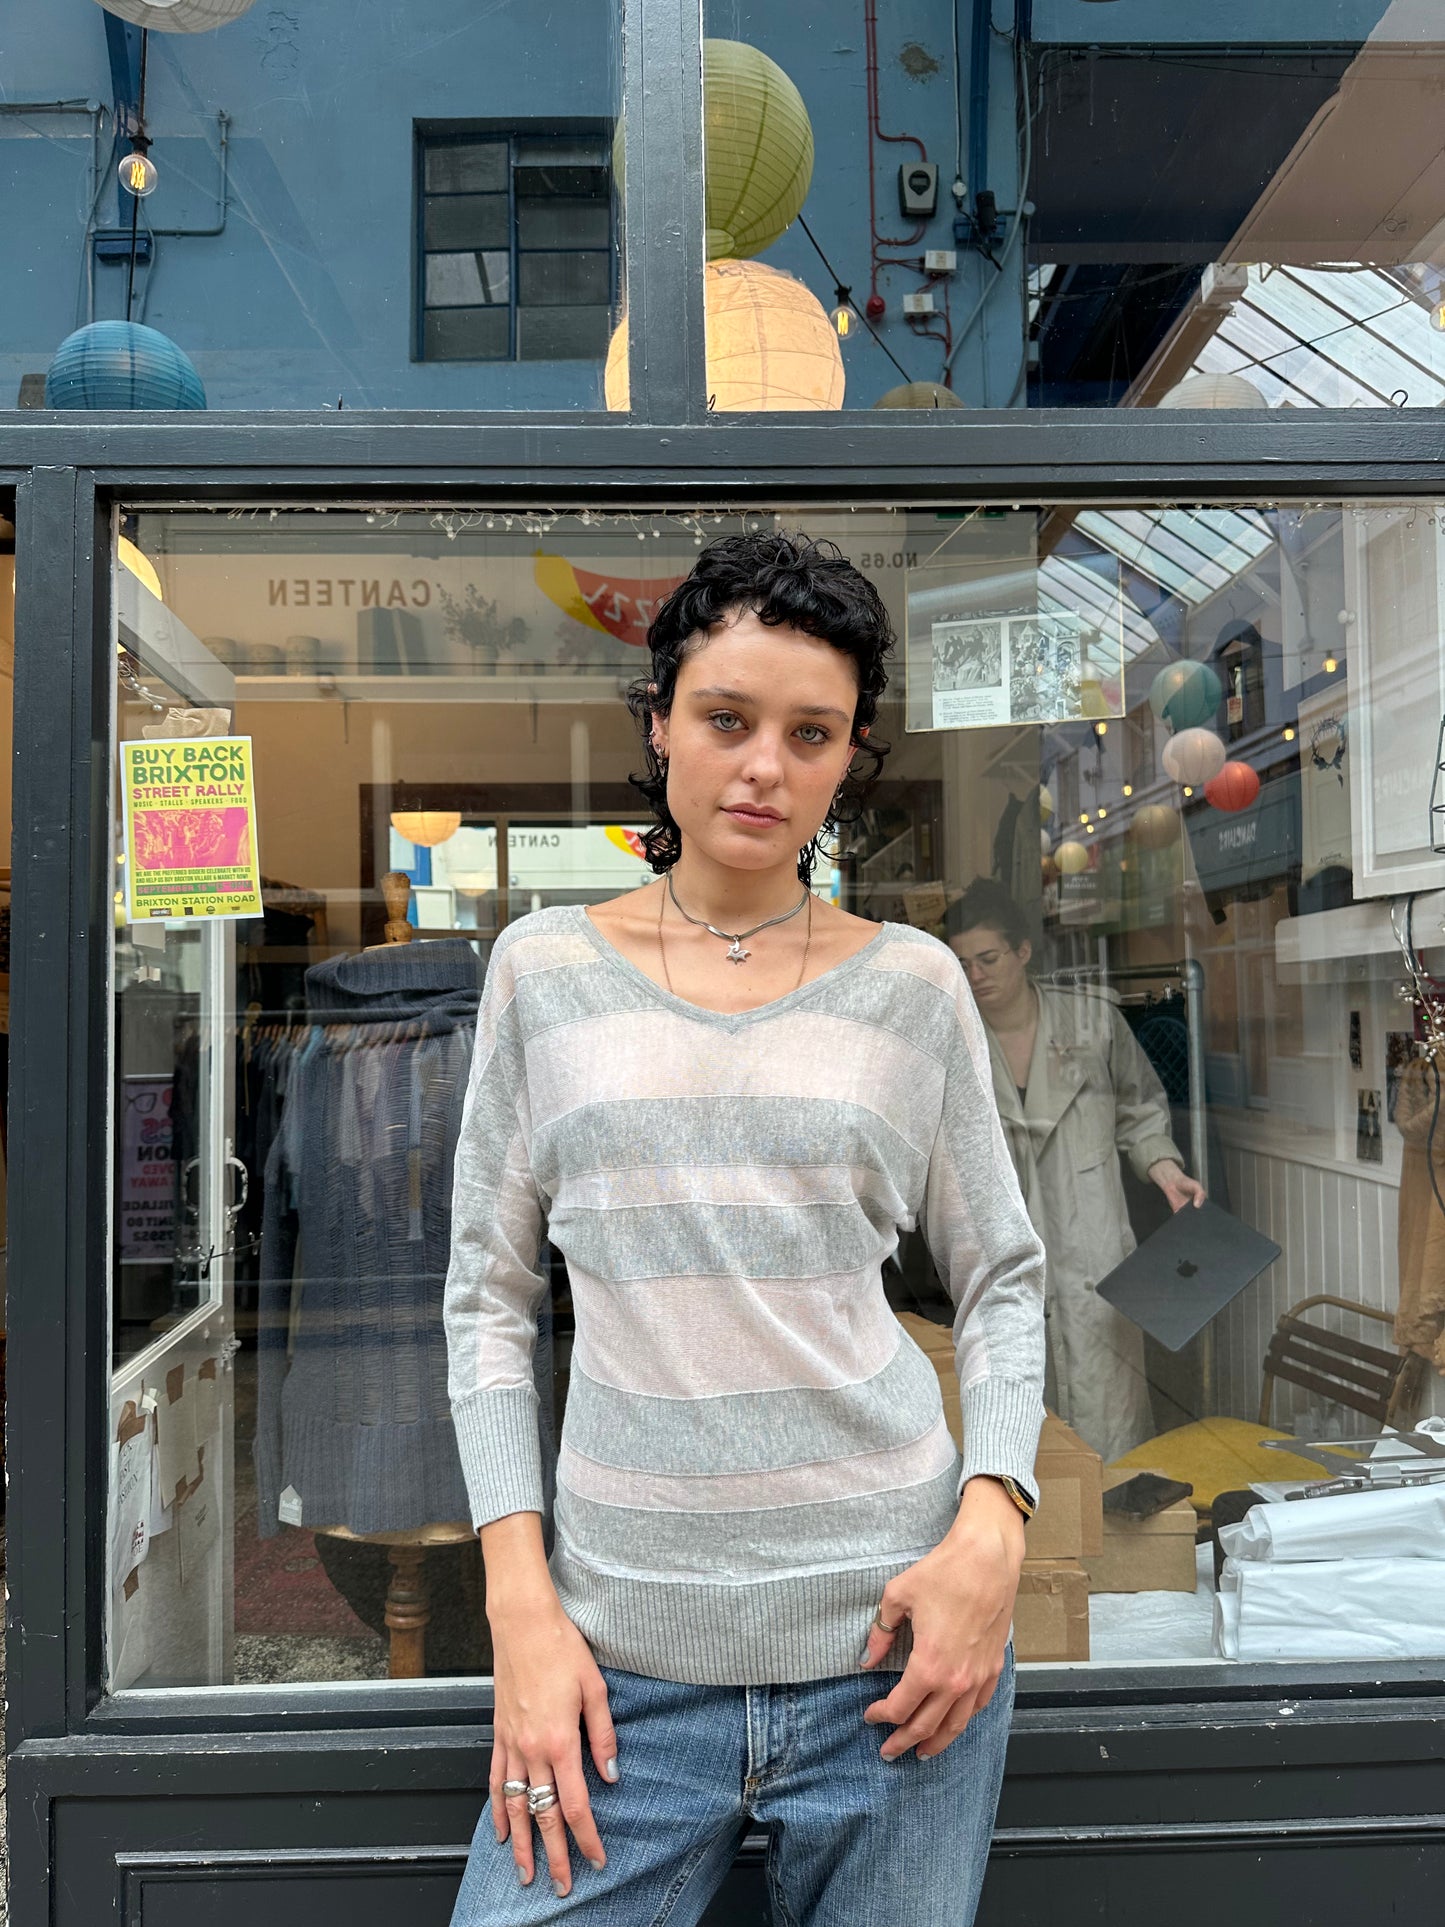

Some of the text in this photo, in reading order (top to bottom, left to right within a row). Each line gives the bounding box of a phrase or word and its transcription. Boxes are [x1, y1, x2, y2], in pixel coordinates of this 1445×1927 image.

[132, 746, 244, 765] BUY BACK
[133, 763, 245, 785] BRIXTON
[133, 783, 244, 799] STREET RALLY
[137, 885, 194, 894] SEPTEMBER
[136, 894, 255, 907] BRIXTON STATION ROAD
